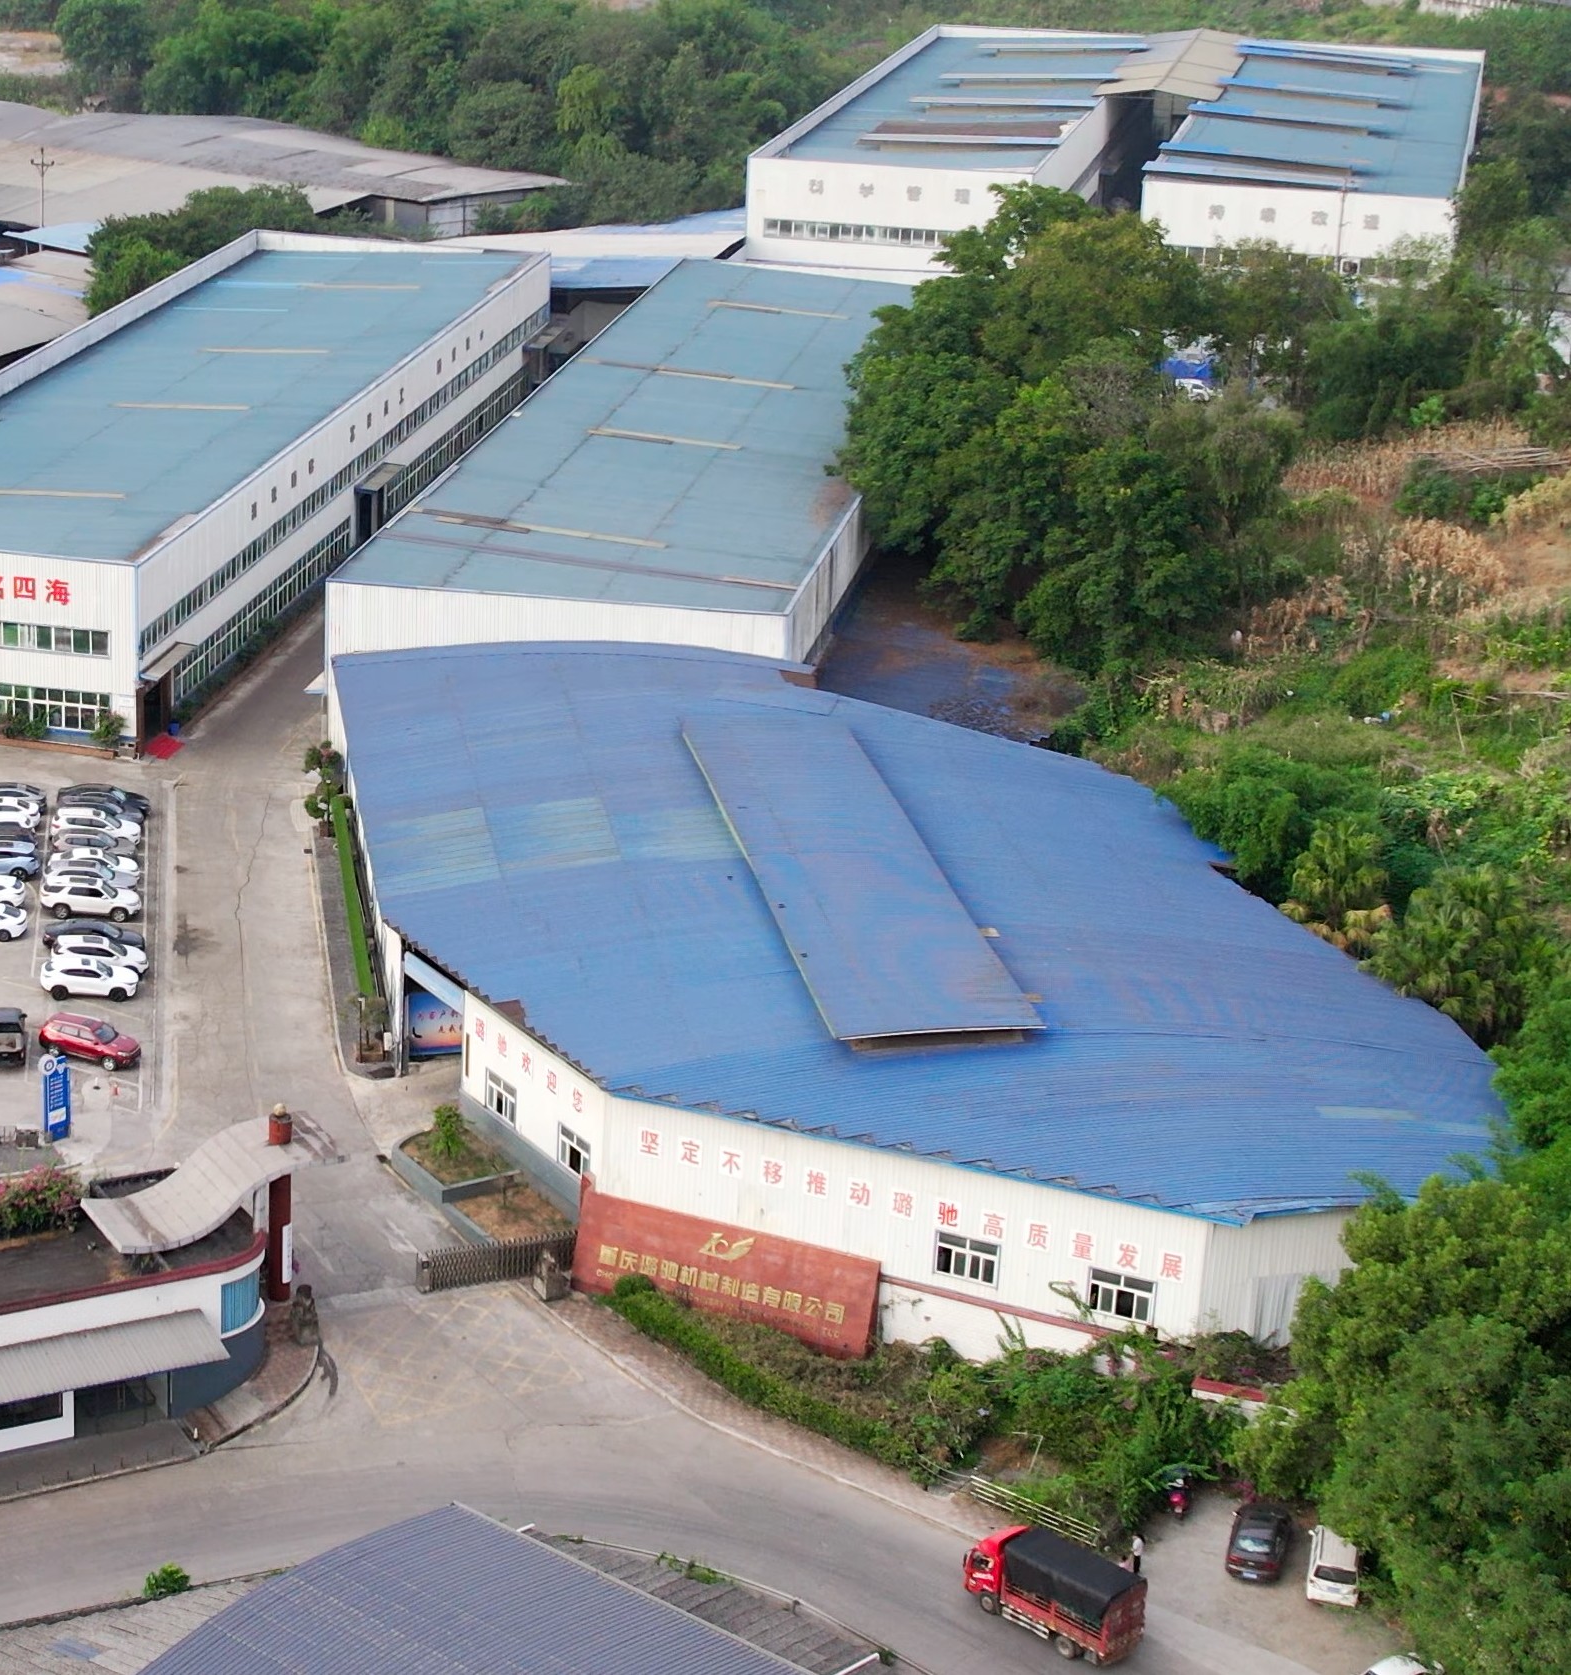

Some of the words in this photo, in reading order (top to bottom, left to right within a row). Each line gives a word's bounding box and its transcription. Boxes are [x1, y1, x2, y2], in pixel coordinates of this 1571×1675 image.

[476, 1017, 583, 1114] 璐驰欢迎您
[640, 1129, 1184, 1279] 坚定不移推动璐驰高质量发展
[597, 1243, 846, 1325] 重庆璐驰机械制造有限公司
